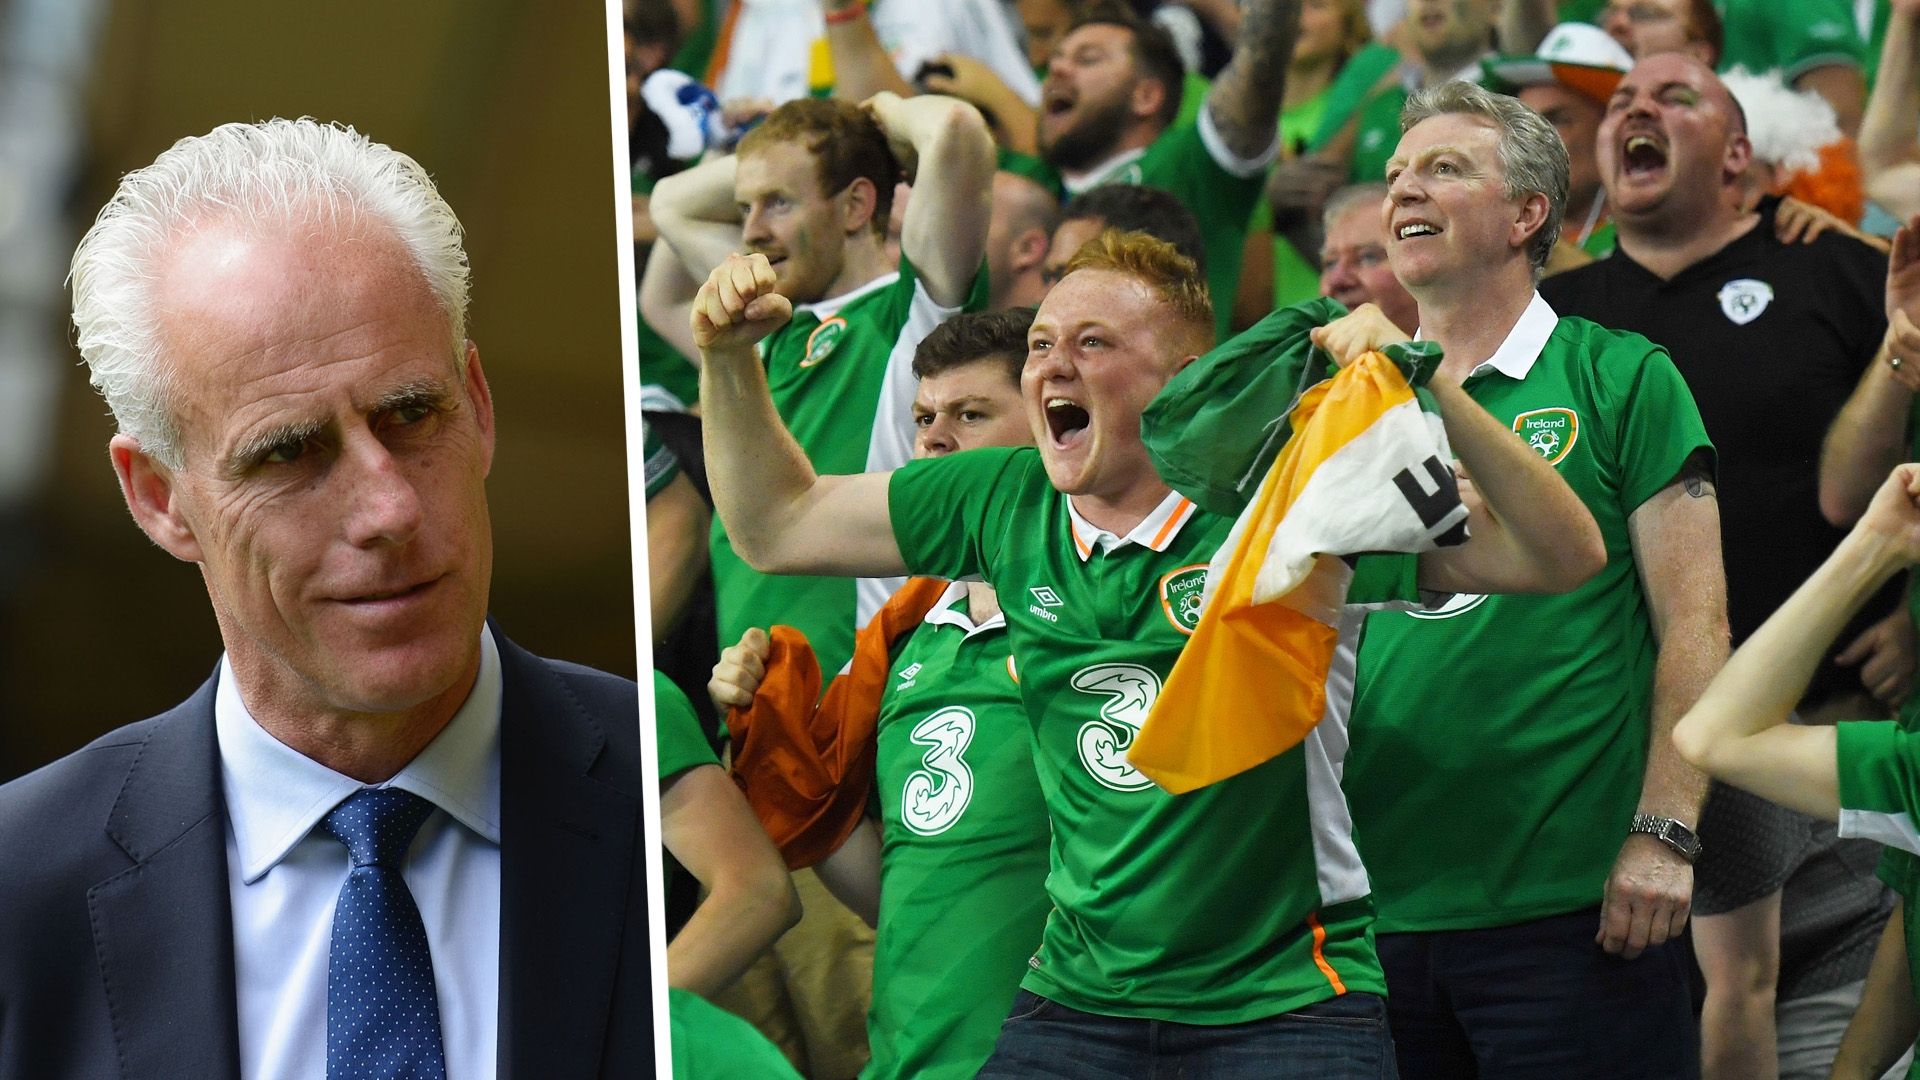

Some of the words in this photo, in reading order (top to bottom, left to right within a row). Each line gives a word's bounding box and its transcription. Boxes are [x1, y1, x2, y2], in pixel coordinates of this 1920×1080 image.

[1526, 417, 1565, 429] Ireland
[1169, 572, 1206, 593] Ireland
[1030, 605, 1058, 622] umbro
[1070, 663, 1163, 792] 3
[901, 705, 976, 836] 3
